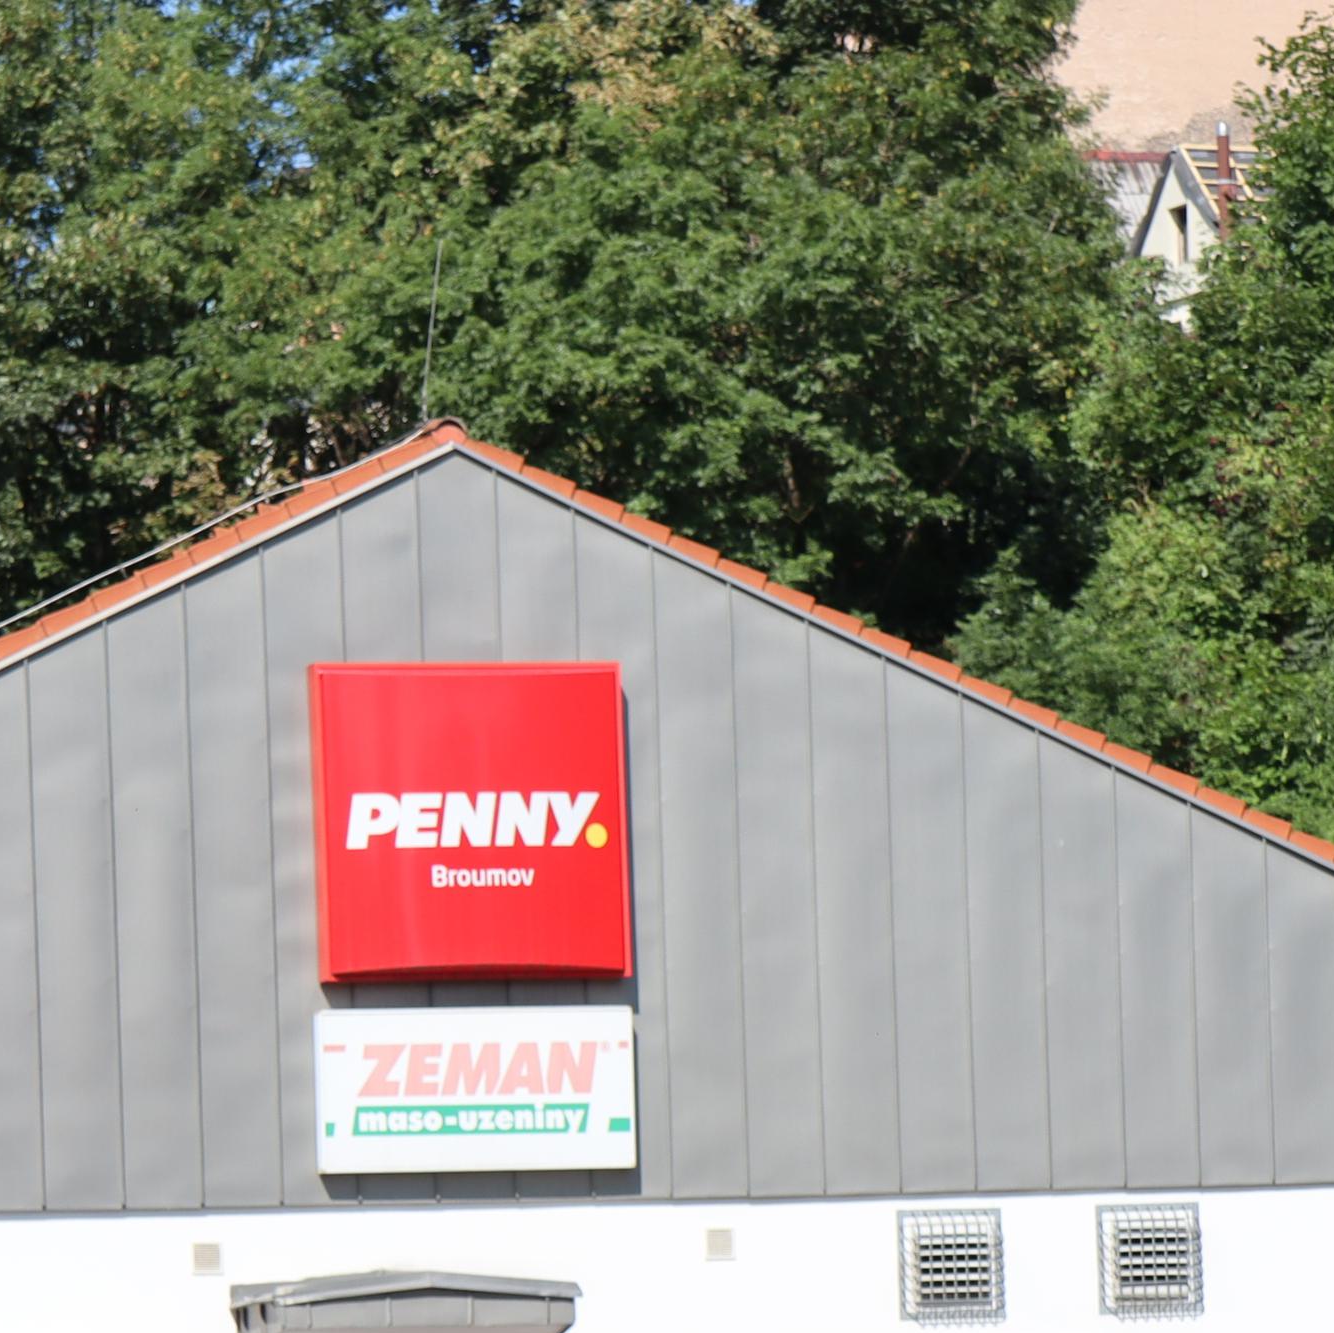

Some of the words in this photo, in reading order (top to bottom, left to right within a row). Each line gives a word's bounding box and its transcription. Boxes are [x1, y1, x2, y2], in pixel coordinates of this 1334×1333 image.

[430, 864, 535, 888] Broumov
[357, 1040, 598, 1097] ZEMAN
[357, 1105, 586, 1134] maso-uzeniny
